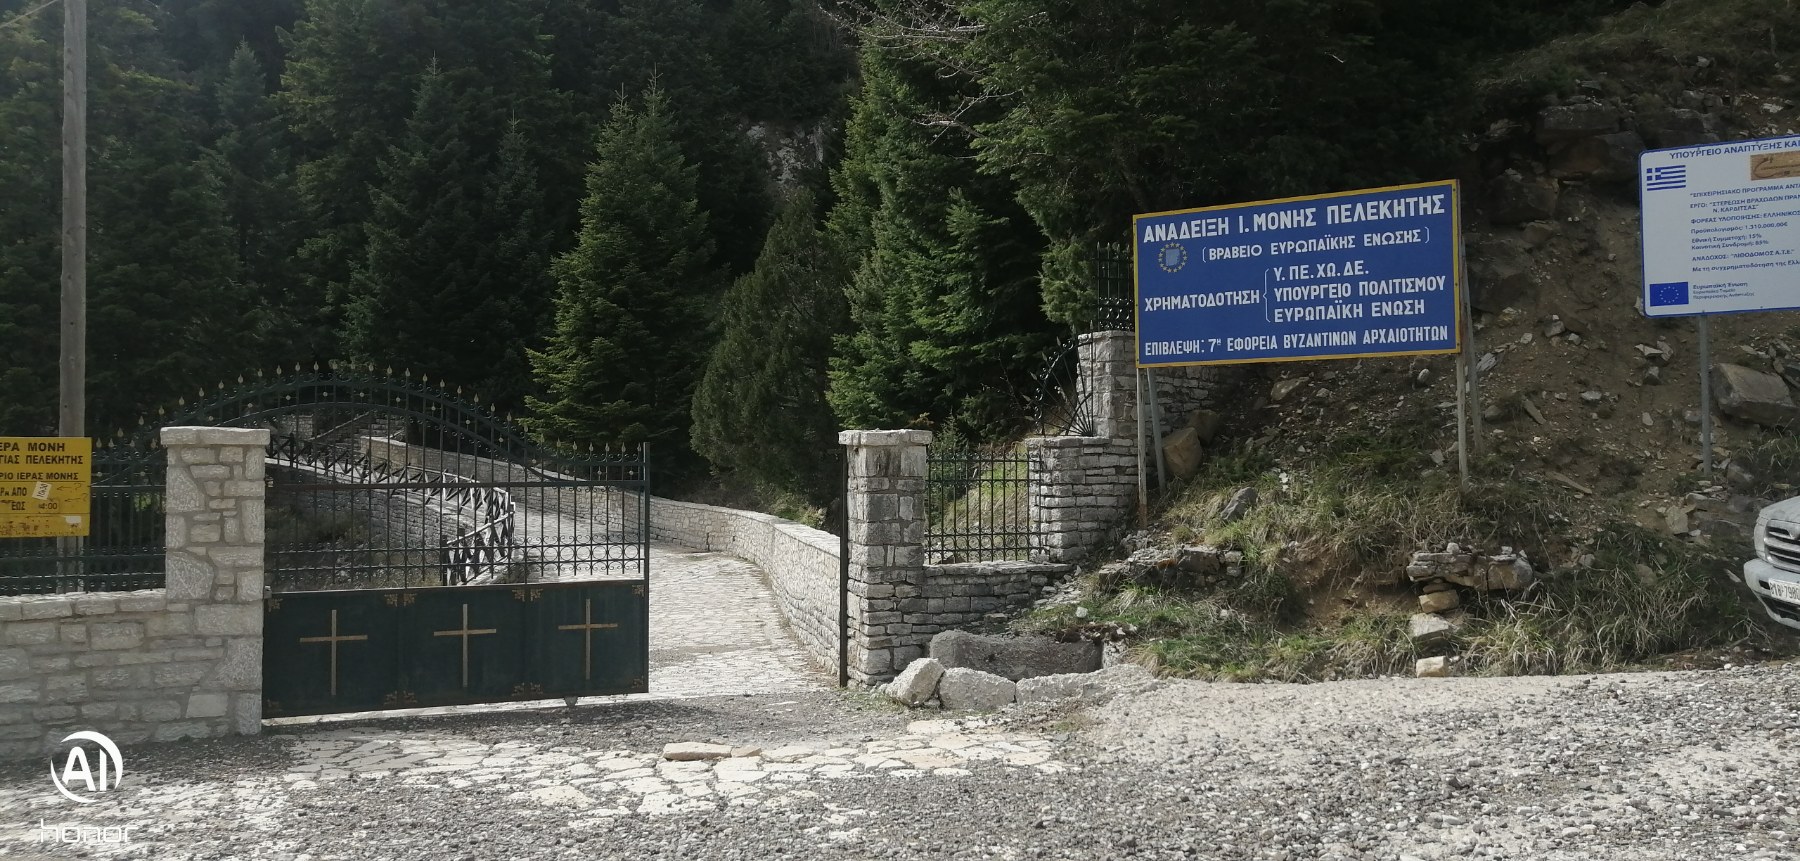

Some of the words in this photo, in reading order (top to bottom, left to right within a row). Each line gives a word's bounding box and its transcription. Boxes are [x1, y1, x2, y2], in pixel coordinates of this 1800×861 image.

[1670, 148, 1722, 159] ΥΠΟΥΡΓΕΙΟ
[1724, 141, 1782, 154] ΑΝΑΠΤΥΞΗΣ
[1143, 217, 1229, 243] ΑΝΑΔΕΙΞΗ
[1253, 207, 1316, 232] ΜΟΝΗΣ
[1326, 194, 1445, 225] ΠΕΛΕΚΗΤΗΣ
[1270, 234, 1356, 255] ΕΥΡΩΠΑΪΚΗΣ
[1273, 283, 1352, 302] ΥΠΟΥΡΓΕΙΟ
[1359, 276, 1446, 297] ΠΟΛΙΤΙΣΜΟΥ
[1145, 290, 1259, 312] ΧΡΗΜΑΤΟΔΟΤΗΣΗ
[1274, 300, 1363, 323] ΕΥΡΩΠΑΪΚΗ
[1371, 299, 1425, 318] ΕΝΩΣΗ
[1145, 339, 1205, 356] ΕΠΙΒΛΕΨΗ:
[1227, 335, 1278, 352] ΕΦΟΡΕΙΑ
[1283, 330, 1357, 350] ΒΥΖΑΝΤΙΝΩΝ
[1363, 326, 1448, 345] ΑΡΧΑΙΟΤΗΤΩΝ
[28, 442, 66, 452] ΜΟΝΗ
[26, 455, 84, 465] ΠΕΛΕΚΗΤΗΣ
[17, 472, 43, 480] ΙΕΡΑΣ
[46, 472, 79, 480] ΜΟΝΗΣ
